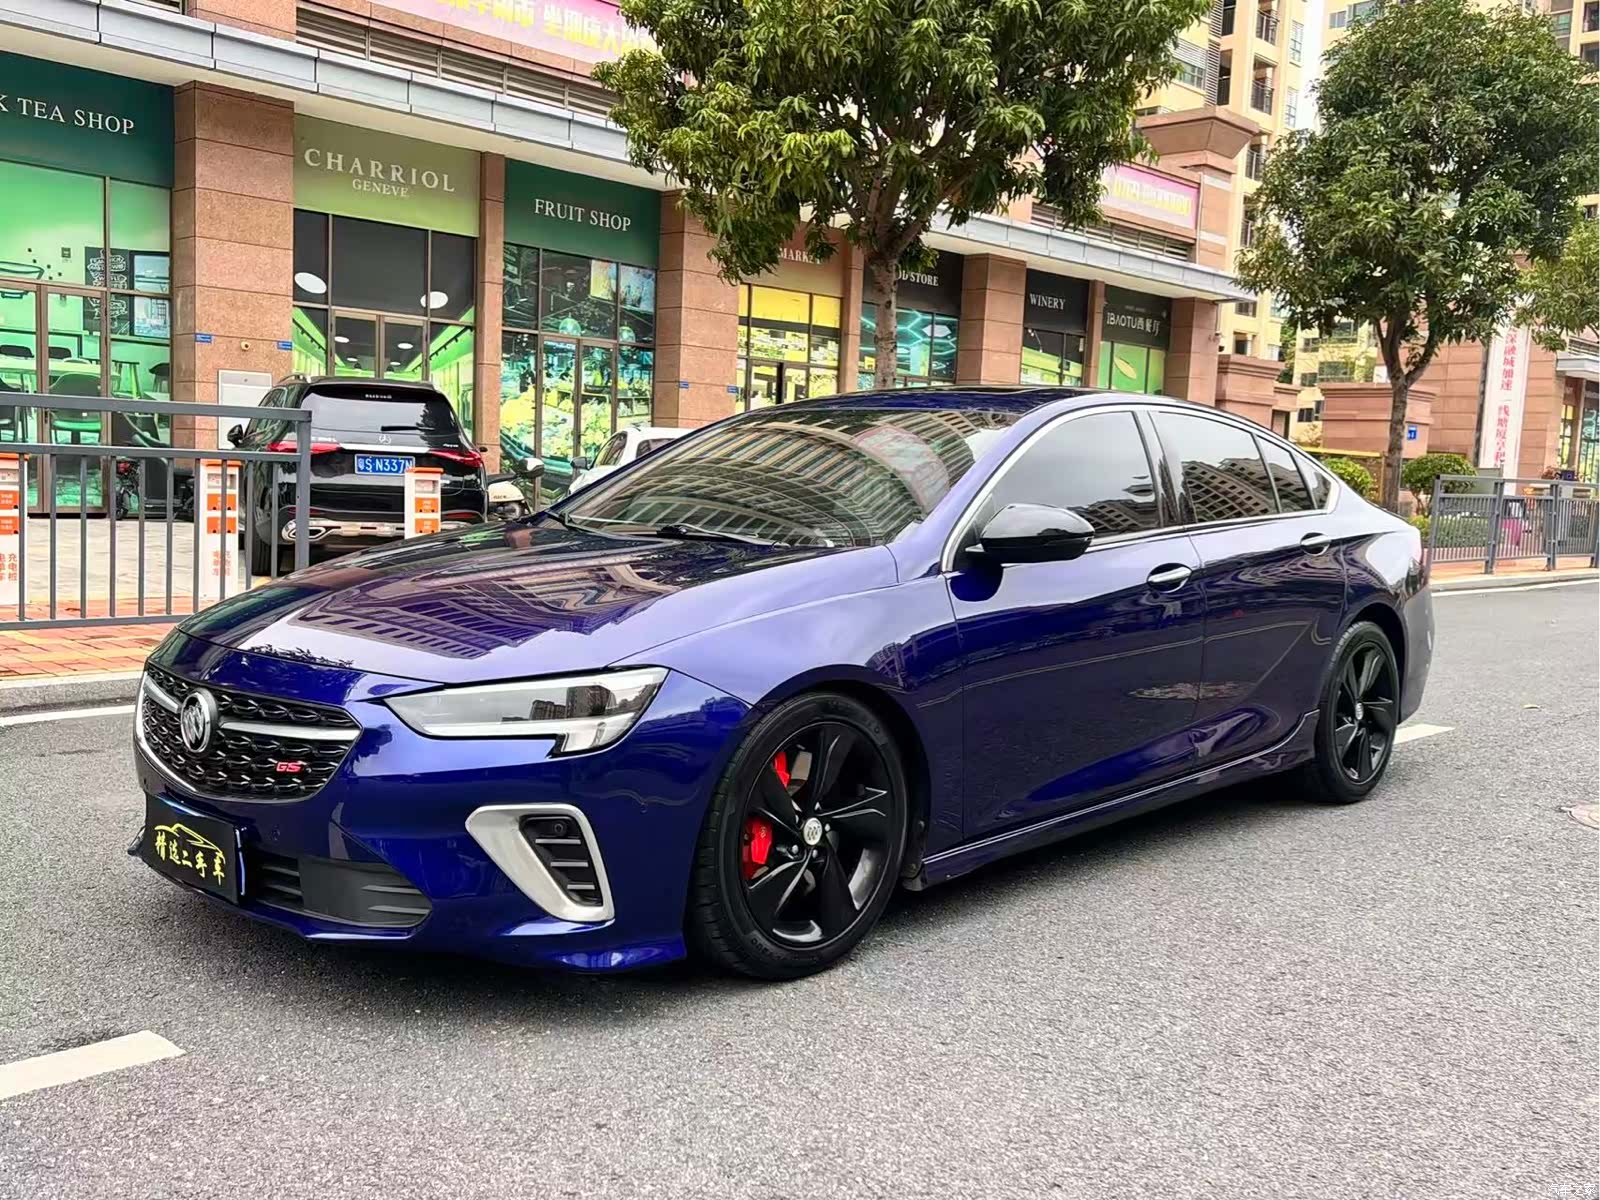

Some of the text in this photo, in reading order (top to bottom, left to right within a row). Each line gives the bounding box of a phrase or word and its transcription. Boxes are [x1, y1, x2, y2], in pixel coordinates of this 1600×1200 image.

[17, 97, 65, 123] TEA
[74, 108, 134, 135] SHOP
[304, 148, 455, 192] CHARRIOL
[352, 178, 409, 197] GENEVE
[535, 198, 631, 231] FRUIT SHOP
[910, 271, 939, 286] STORE
[1030, 293, 1065, 310] WINERY
[276, 761, 301, 772] GS
